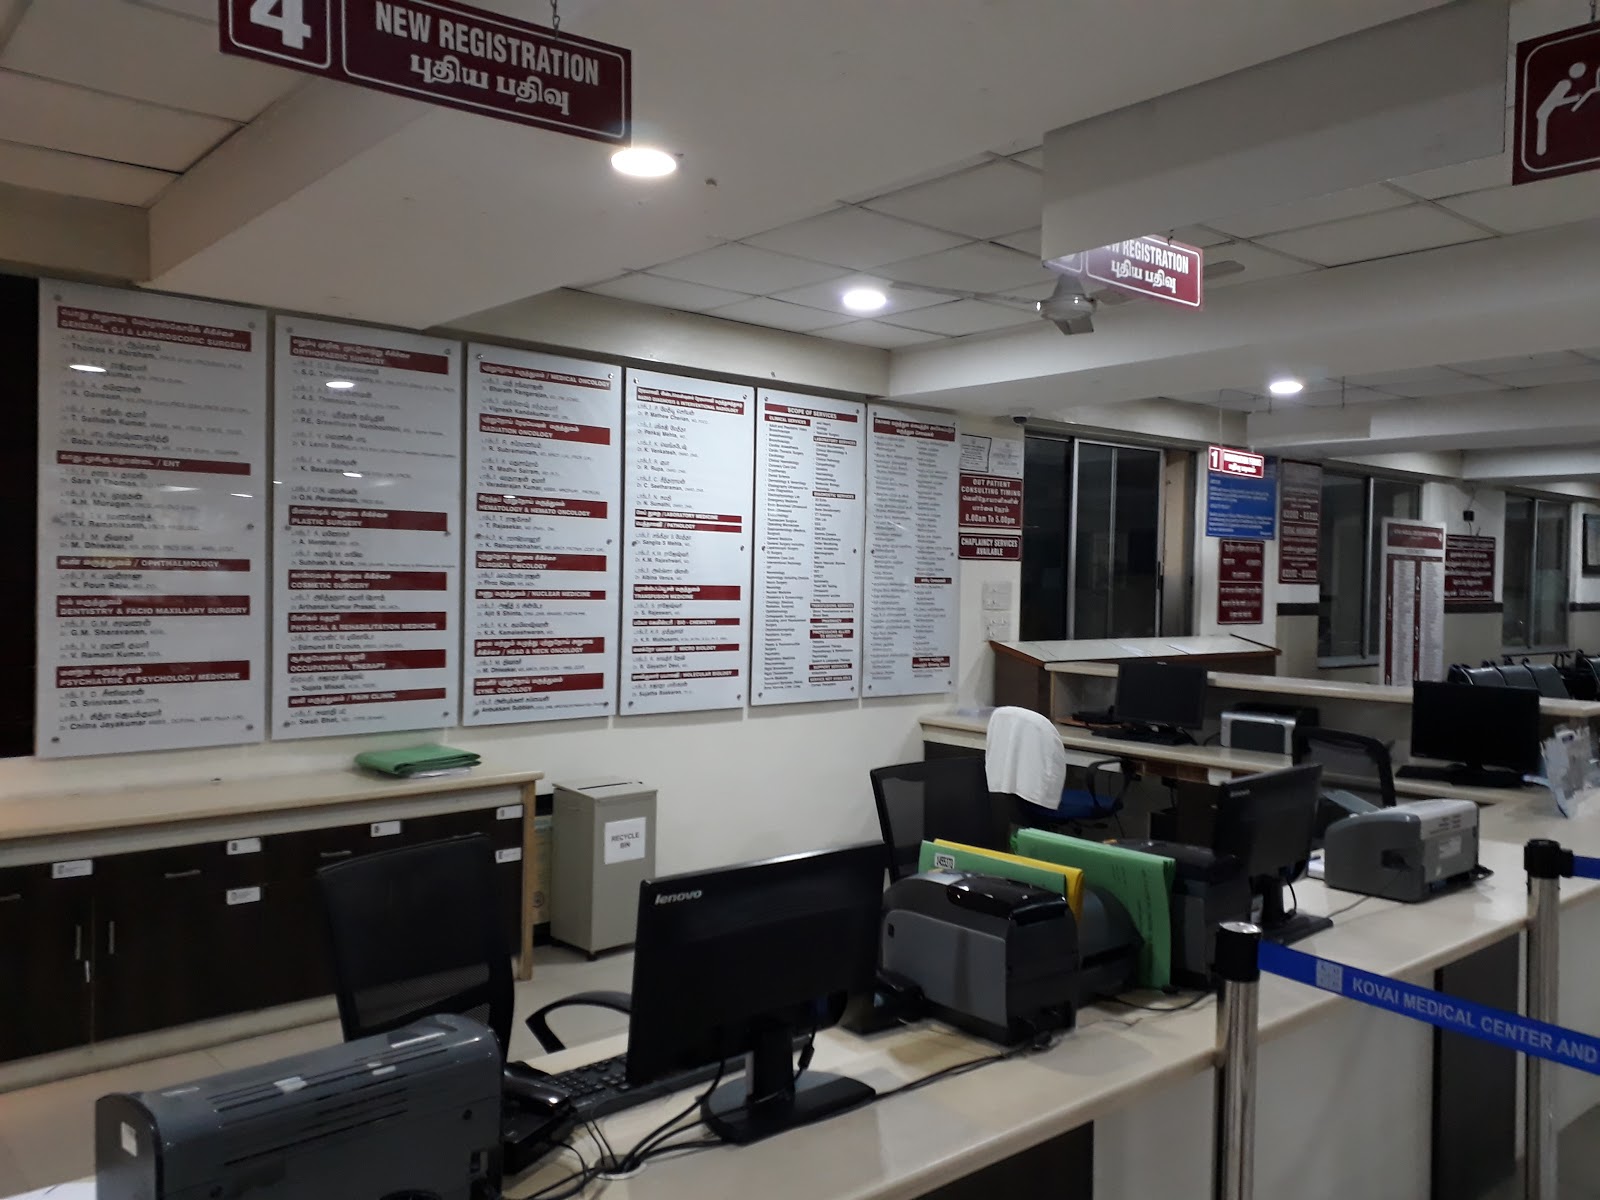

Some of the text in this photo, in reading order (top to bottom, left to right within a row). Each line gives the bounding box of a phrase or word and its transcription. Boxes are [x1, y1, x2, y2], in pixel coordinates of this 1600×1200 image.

[249, 0, 599, 85] 4 NEW REGISTRATION
[410, 53, 570, 116] புதிய பதிவு
[1123, 240, 1189, 274] REGISTRATION
[1111, 260, 1176, 293] புதிய பதிவு
[207, 340, 247, 349] SURGERY
[350, 354, 384, 364] SURGERY
[551, 375, 576, 383] MEDICAL
[579, 378, 610, 387] ONCOLOGY
[788, 407, 804, 415] SCOPE
[813, 411, 837, 419] SERVICES
[482, 426, 553, 438] RADIATION ONCOLOGY
[1211, 451, 1218, 468] 1
[961, 486, 998, 495] CONSULTING
[292, 518, 362, 526] PLASTIC SURGERY
[961, 538, 1017, 548] CHAPLAINCY SERVICES
[976, 548, 1003, 556] AVAILABLE
[141, 560, 218, 568] OPHTHALMOLOGY
[352, 662, 386, 670] THERAPY
[60, 677, 123, 687] PSYCHIATRIC
[136, 674, 195, 684] PSYCHOLOGY
[611, 832, 640, 842] RECYCLE
[655, 890, 702, 904] lenovo
[1352, 977, 1597, 1063] KOVAI MEDICAL CENTER AND
